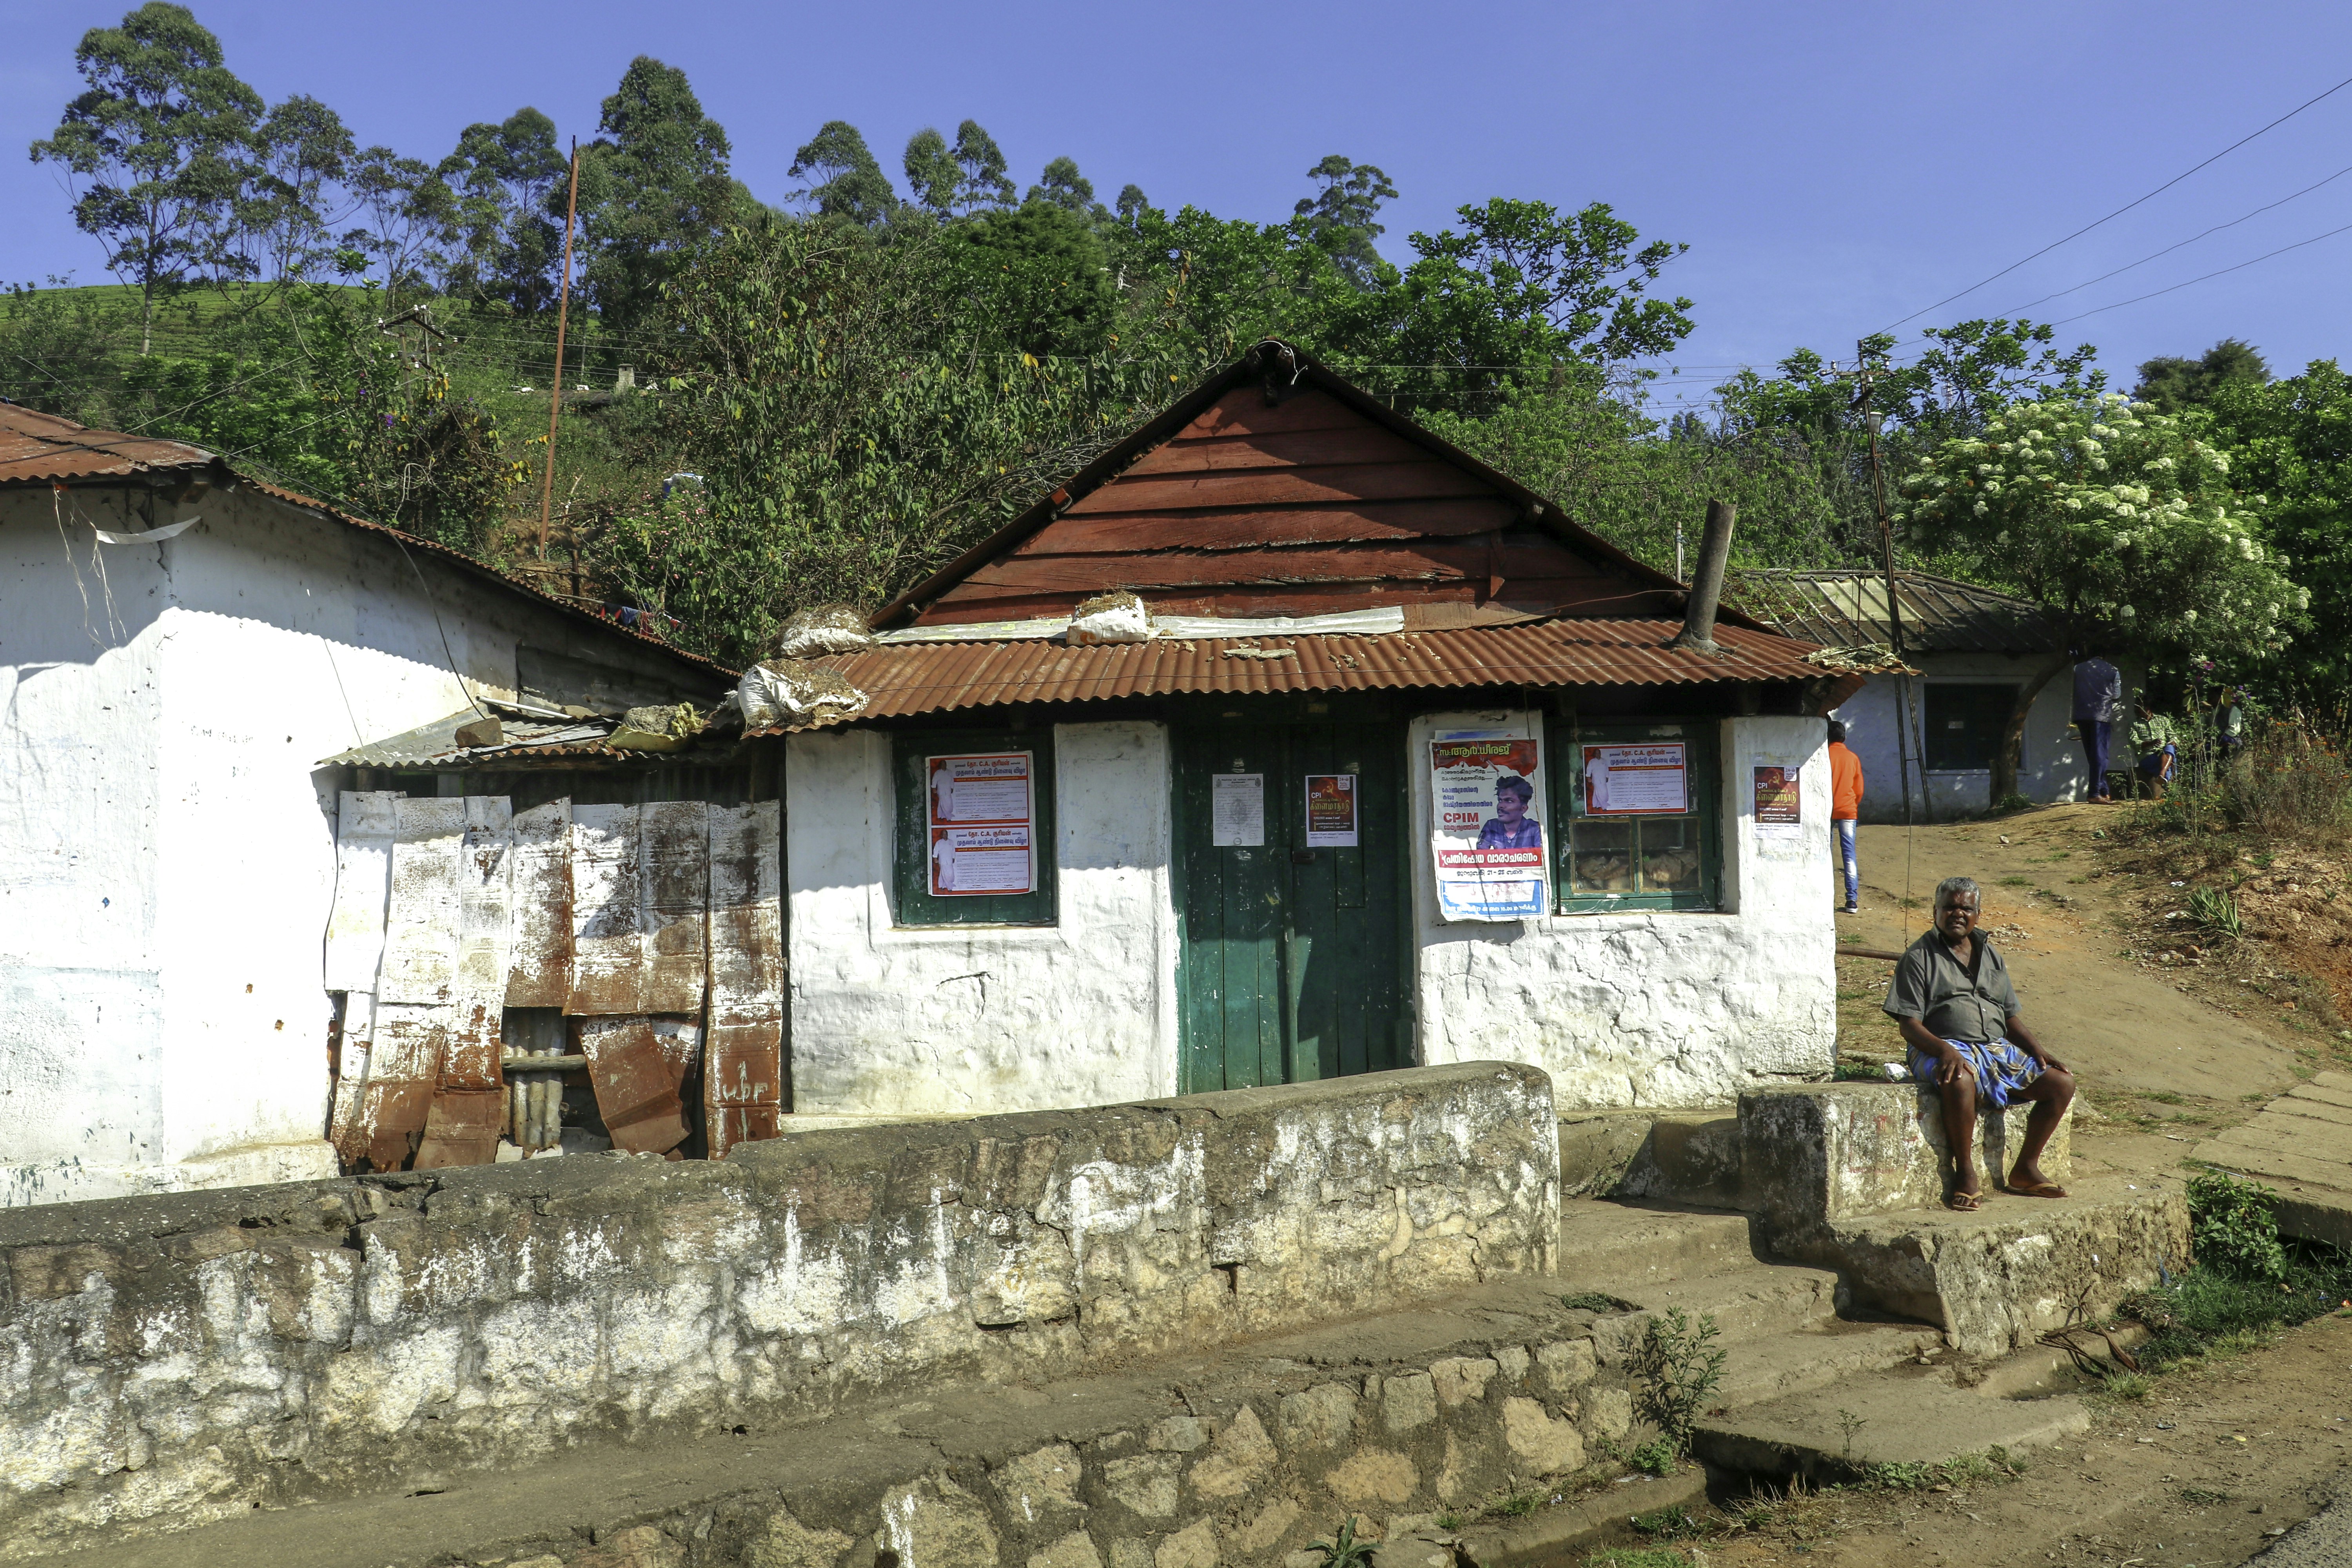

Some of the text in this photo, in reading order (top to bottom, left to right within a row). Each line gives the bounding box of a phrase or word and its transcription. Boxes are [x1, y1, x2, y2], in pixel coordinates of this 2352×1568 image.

[1610, 757, 1630, 766] முதலாம்
[1648, 757, 1668, 765] நினைவு
[1669, 756, 1681, 764] விழா
[955, 767, 1025, 777] முதலாம் ஆண்டு நினைவு விழா
[1756, 791, 1796, 804] கிளைமாநாடு
[1310, 800, 1350, 812] கிளைமாநாடு
[1443, 812, 1479, 823] CPIM
[995, 837, 1014, 846] நினைவு
[1015, 837, 1027, 845] விழா
[1444, 852, 1538, 865] പ്രതിഷേധ വാരാചരണം
